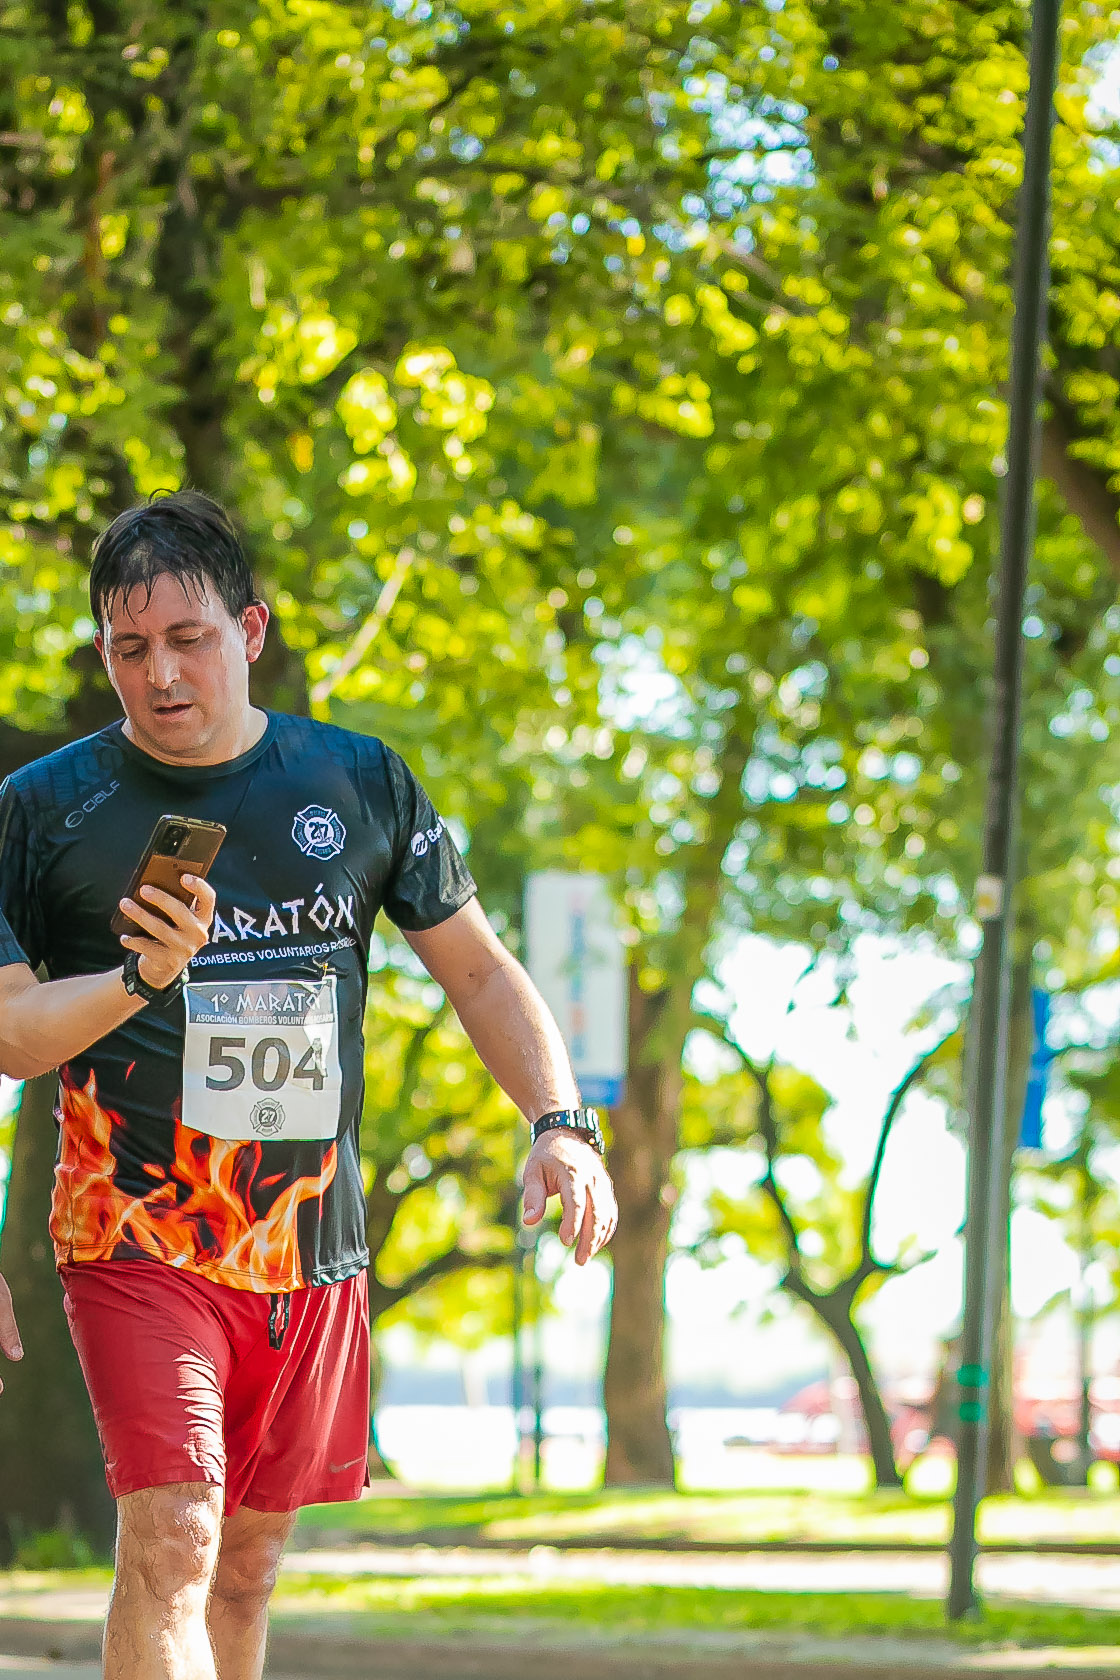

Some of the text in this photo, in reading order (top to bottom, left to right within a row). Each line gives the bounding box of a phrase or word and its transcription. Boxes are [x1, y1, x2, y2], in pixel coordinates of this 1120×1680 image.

[211, 882, 354, 944] ARATÓN
[191, 951, 256, 968] BOMBEROS
[255, 942, 330, 961] VOLUNTARIOS
[238, 1015, 277, 1025] BOMBEROS
[205, 1036, 328, 1092] 504
[260, 1109, 276, 1124] 27
